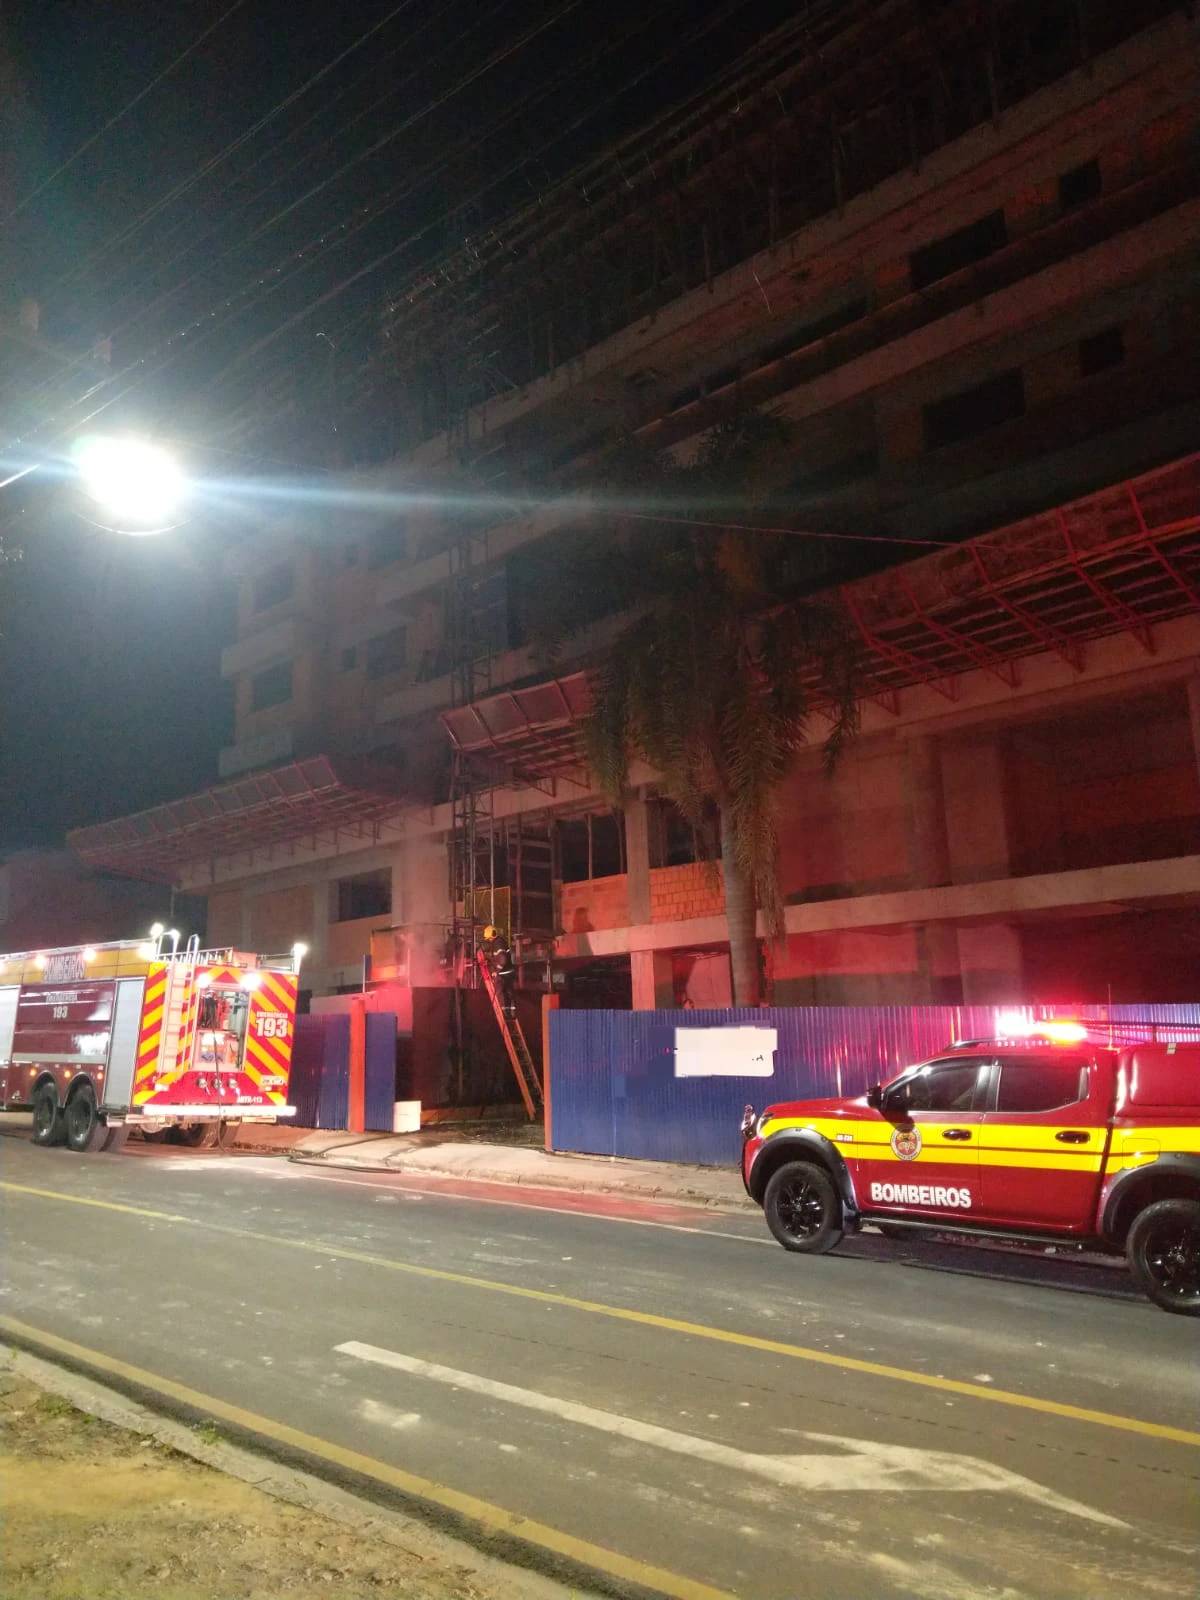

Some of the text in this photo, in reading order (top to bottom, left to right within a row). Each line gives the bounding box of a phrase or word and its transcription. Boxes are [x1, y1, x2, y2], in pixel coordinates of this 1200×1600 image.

[53, 1005, 68, 1018] 193
[255, 1018, 288, 1038] 193
[870, 1182, 972, 1208] BOMBEIROS
